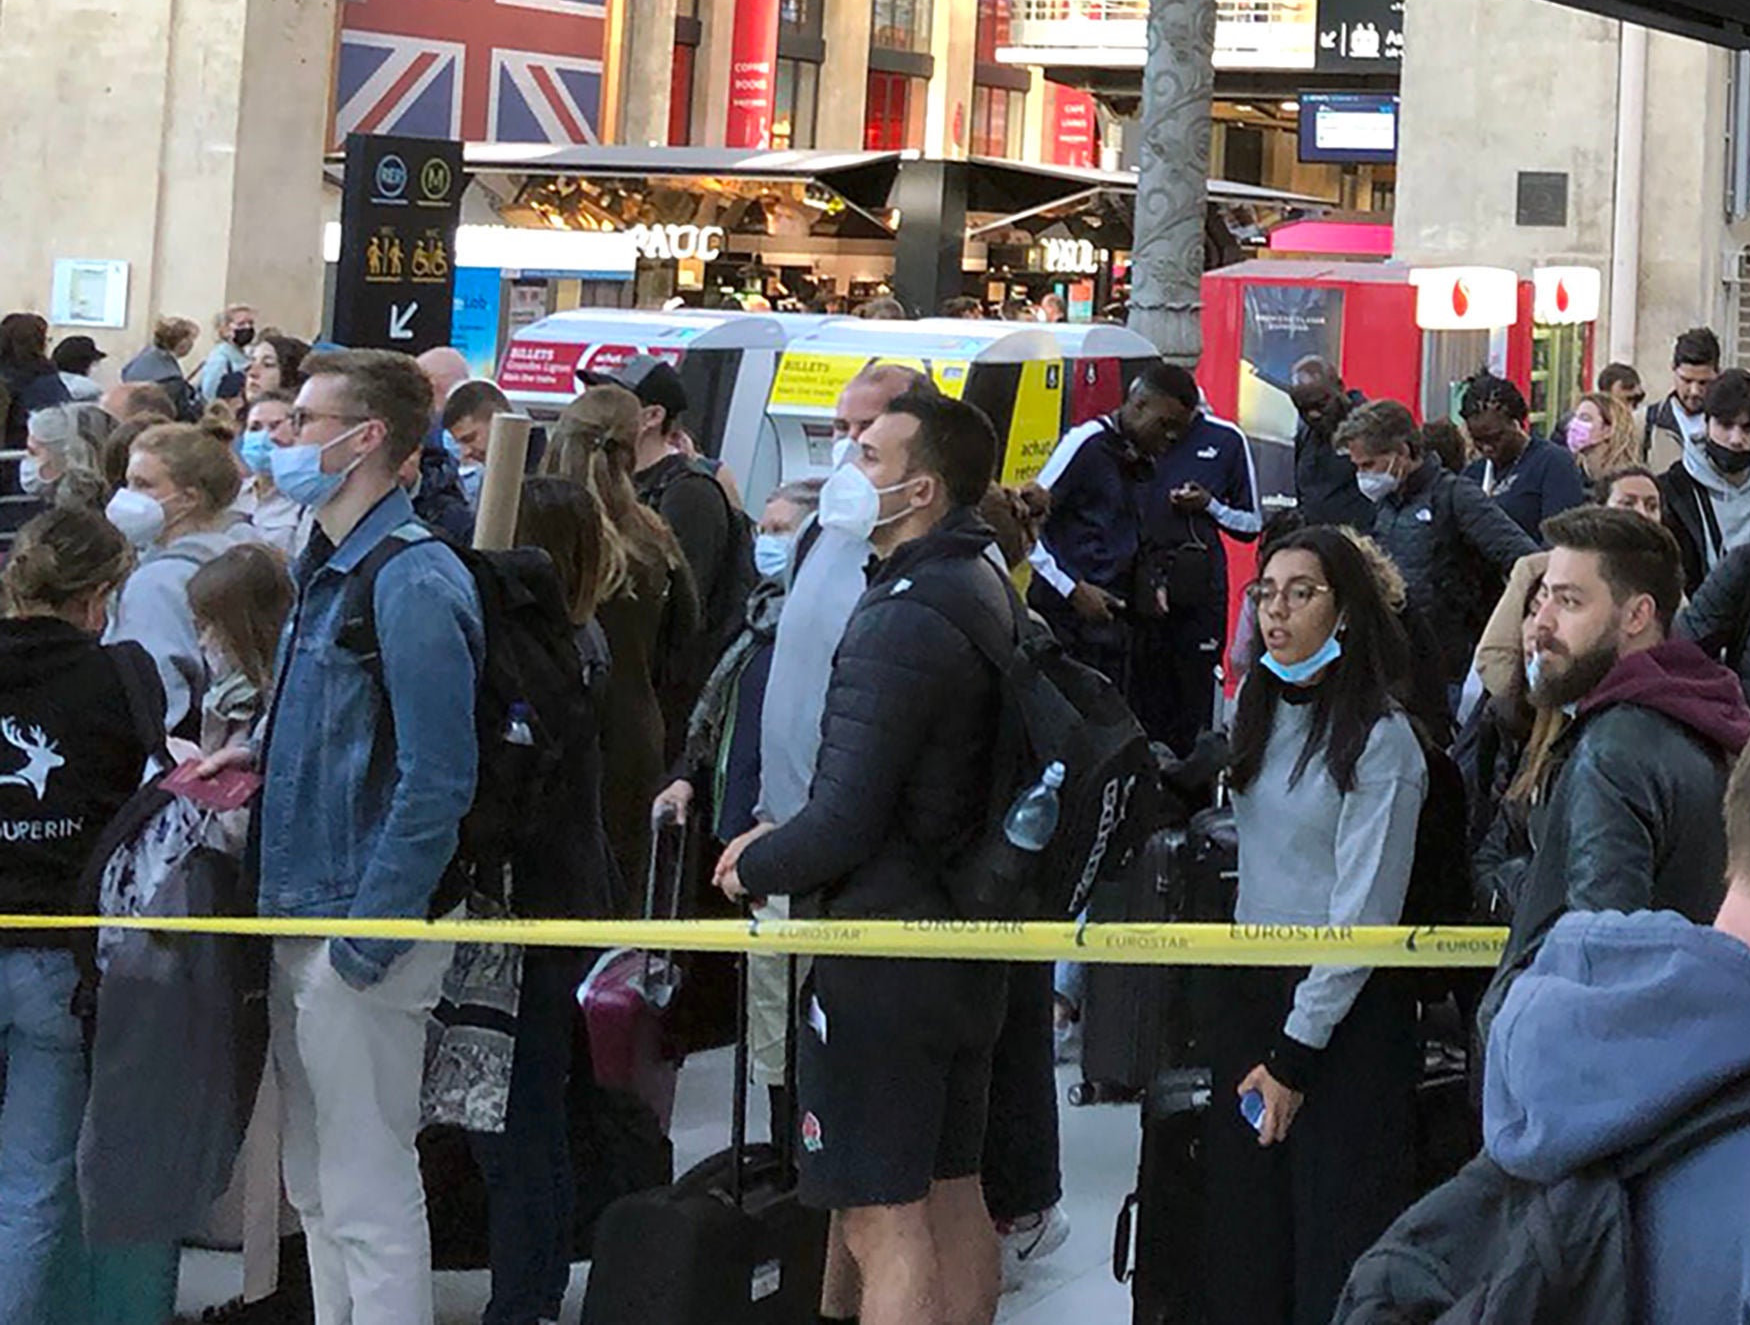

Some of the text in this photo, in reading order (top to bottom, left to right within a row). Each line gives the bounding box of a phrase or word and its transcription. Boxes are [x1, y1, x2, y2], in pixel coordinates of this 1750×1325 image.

[511, 348, 554, 361] BILLETS
[784, 359, 829, 373] BILLETS
[0, 817, 84, 841] UPERIN
[1230, 924, 1354, 943] EUROSTAR
[1106, 935, 1190, 950] EUROSTAR
